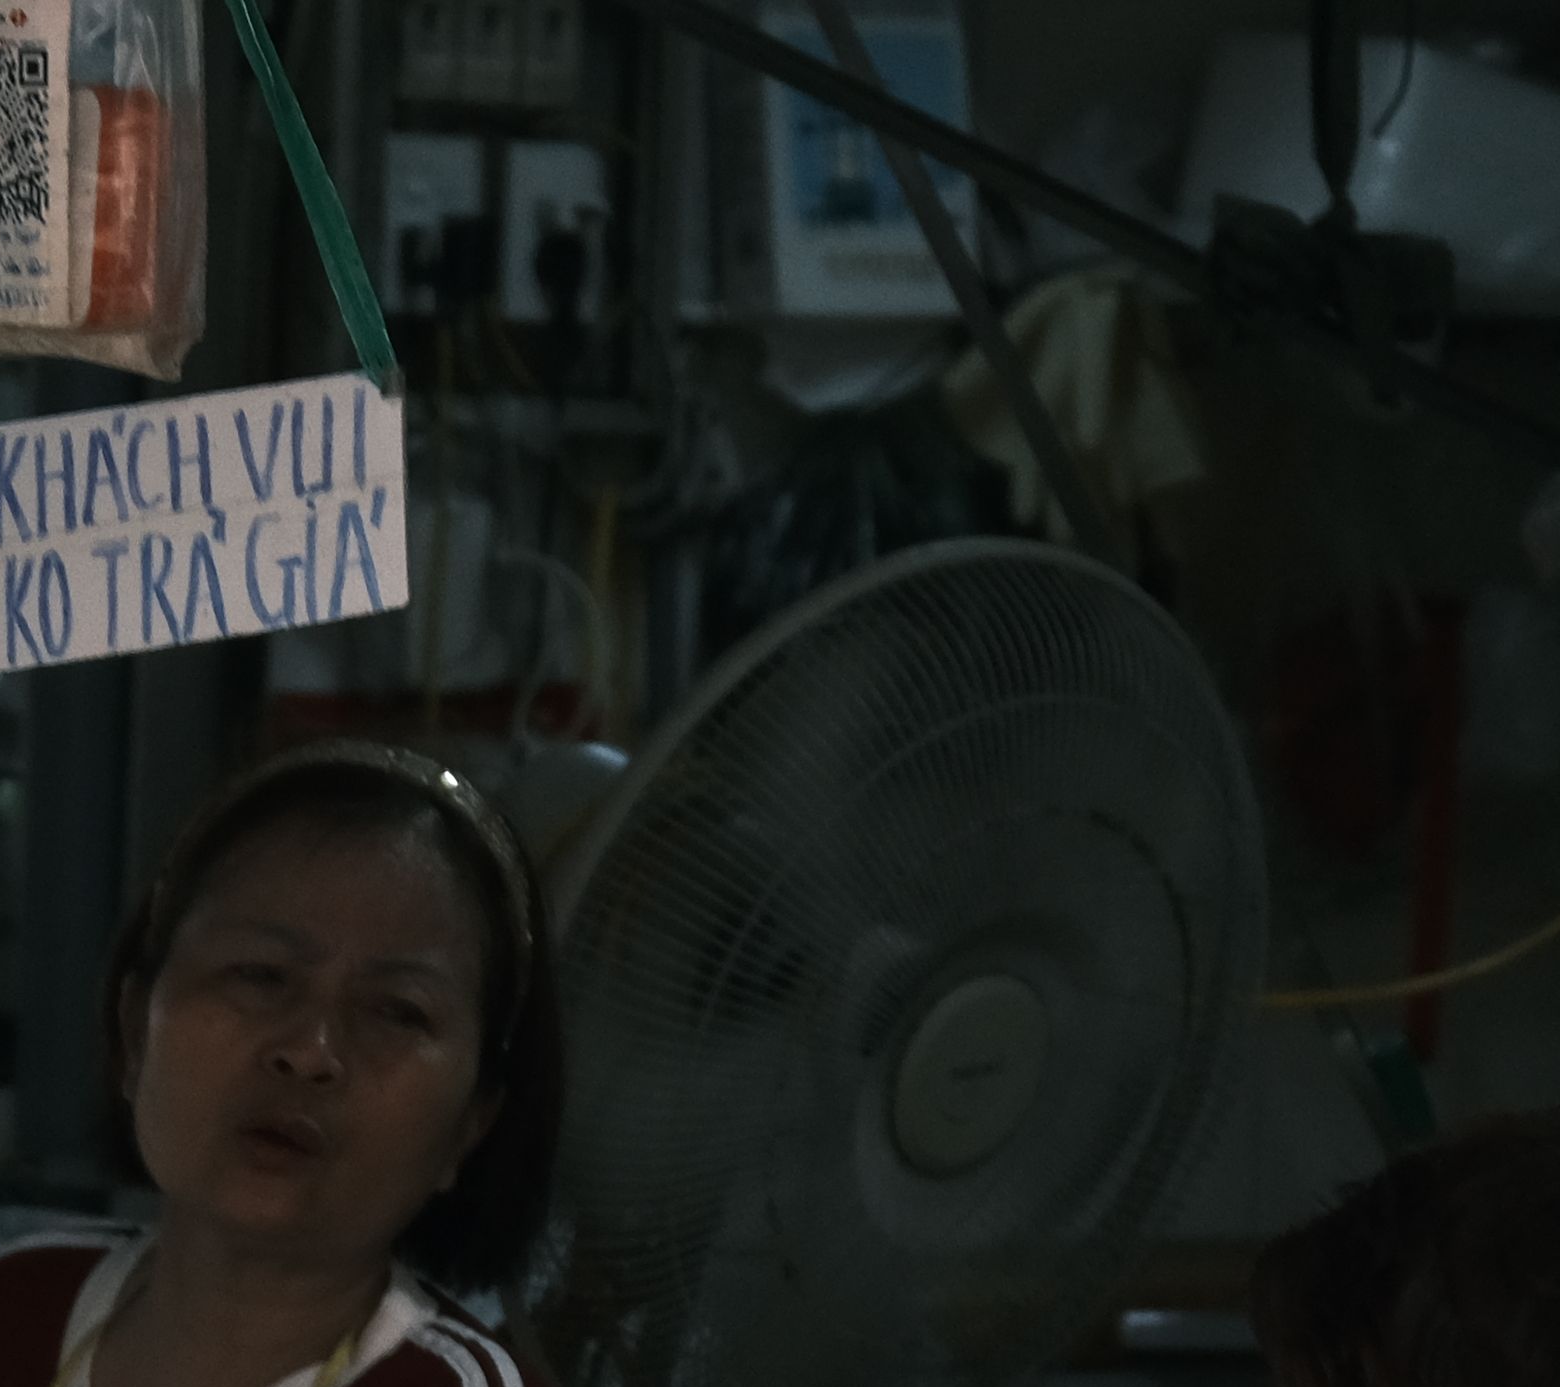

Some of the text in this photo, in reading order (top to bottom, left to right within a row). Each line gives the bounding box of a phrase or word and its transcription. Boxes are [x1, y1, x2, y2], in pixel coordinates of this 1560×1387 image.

[233, 386, 367, 502] VUI
[3, 549, 73, 666] KO
[244, 485, 387, 632] GIÁ
